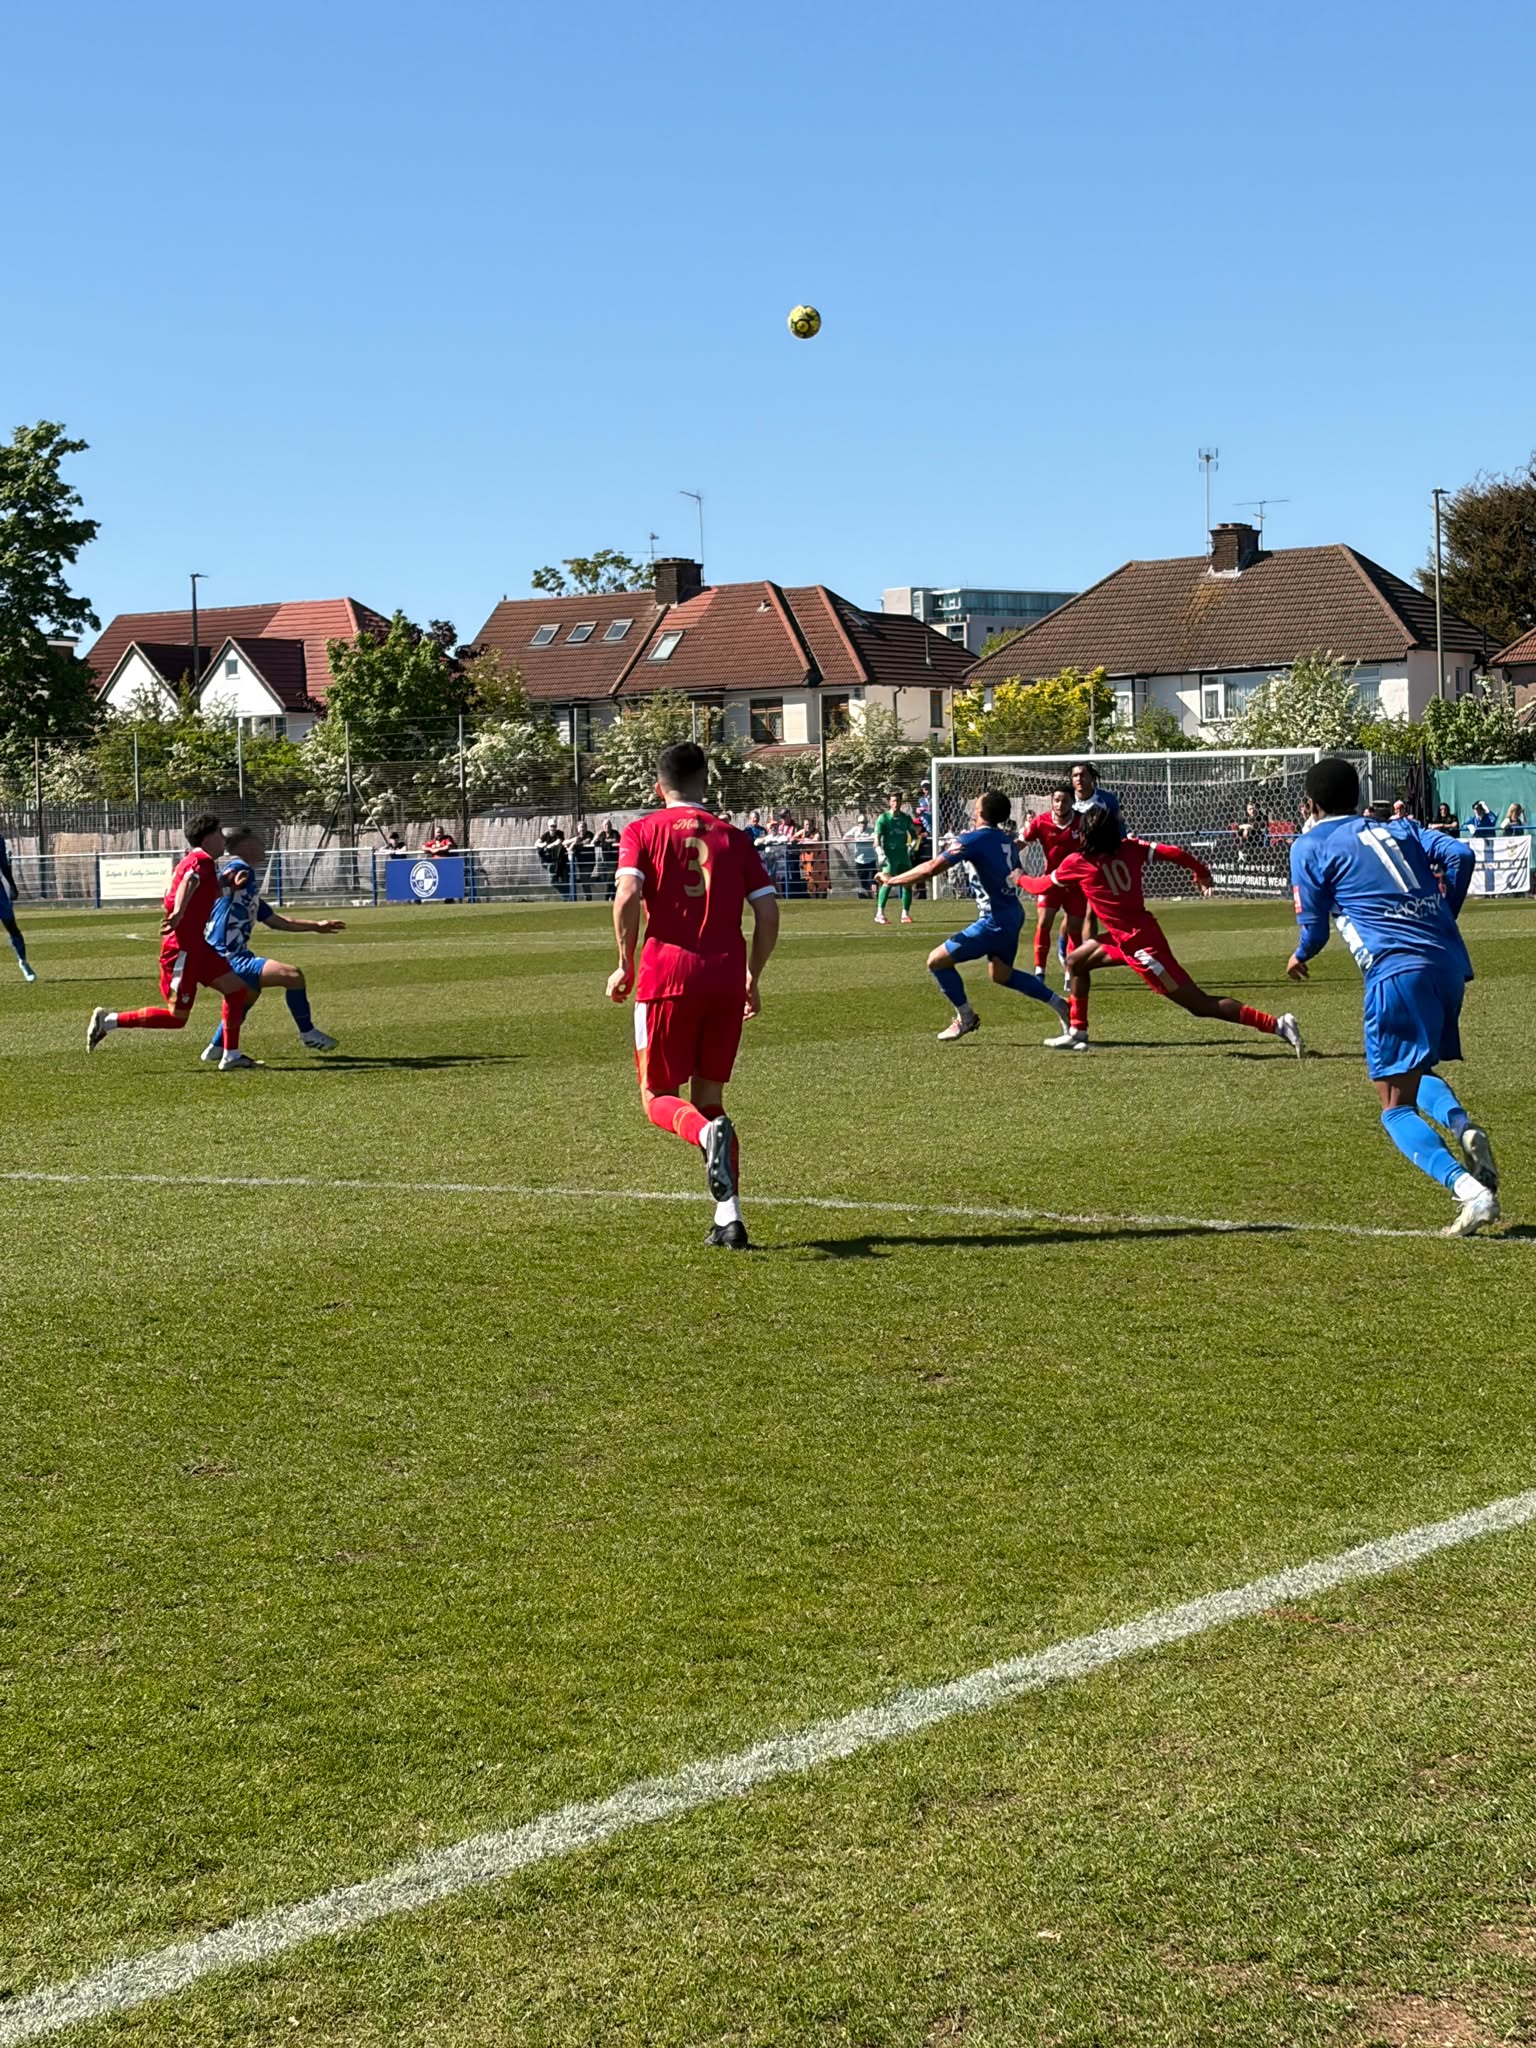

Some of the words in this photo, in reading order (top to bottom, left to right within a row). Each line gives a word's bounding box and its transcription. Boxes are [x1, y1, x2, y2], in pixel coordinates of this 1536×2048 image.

[684, 836, 710, 897] 3
[1102, 860, 1132, 896] 10
[1239, 864, 1275, 872] HARVEST
[1228, 874, 1266, 887] CORPORATE
[1268, 877, 1288, 887] WEAR
